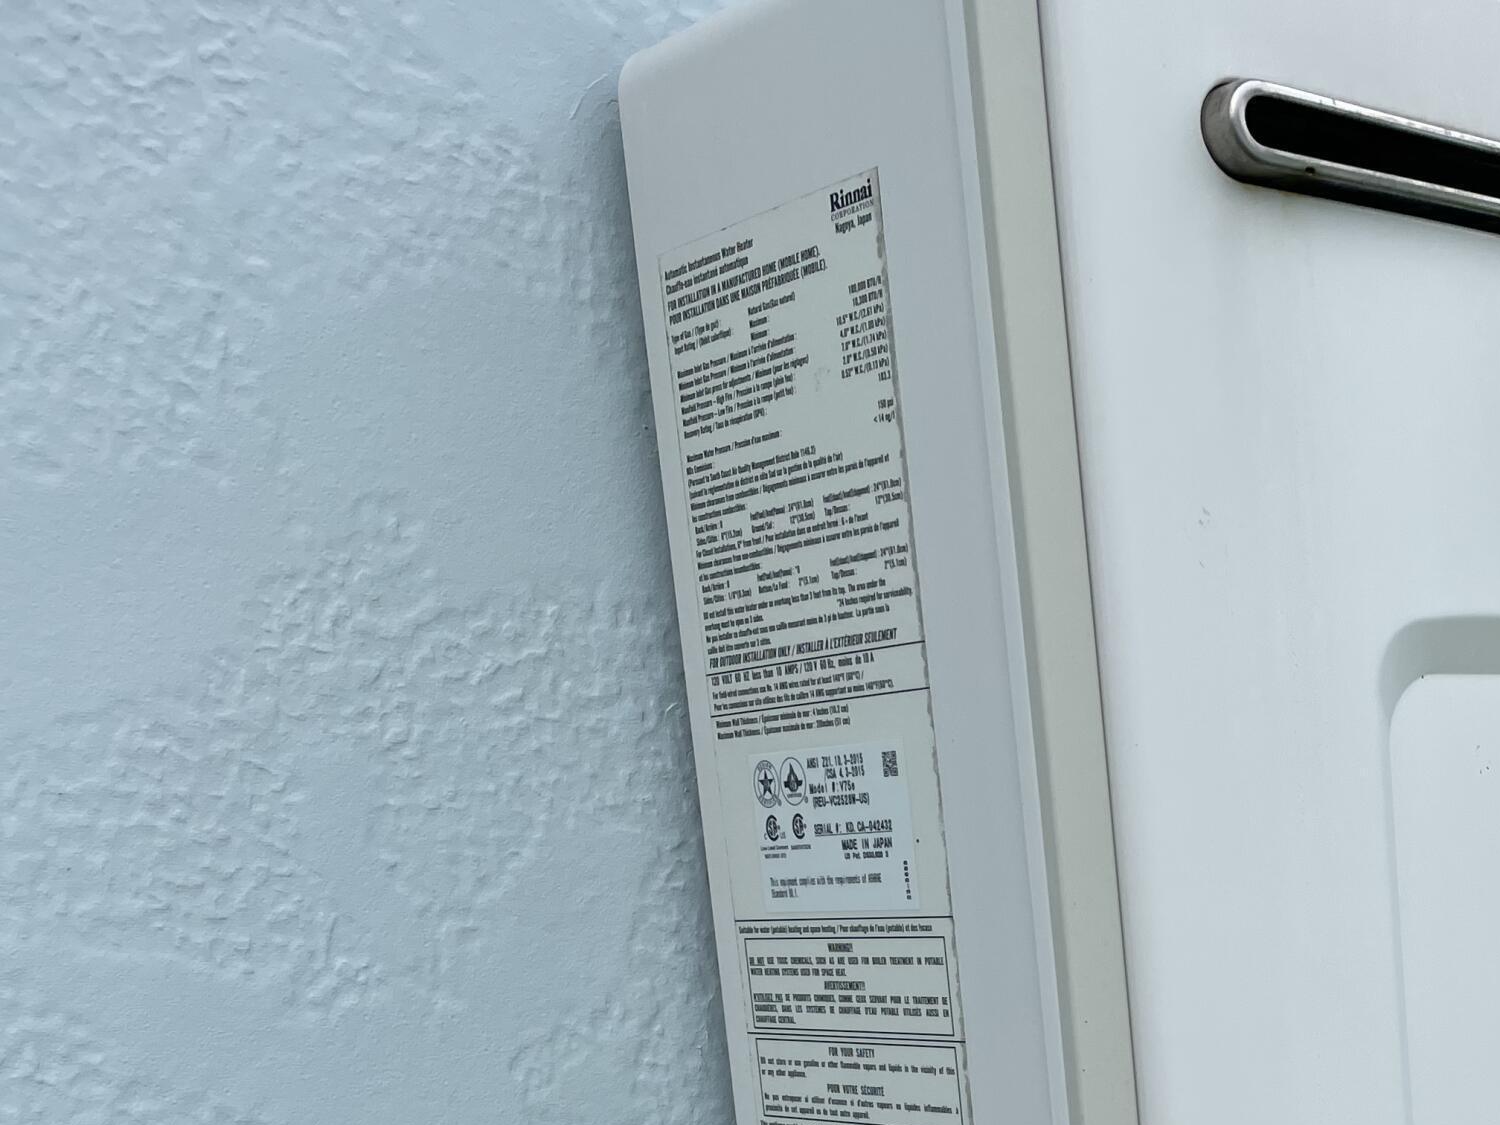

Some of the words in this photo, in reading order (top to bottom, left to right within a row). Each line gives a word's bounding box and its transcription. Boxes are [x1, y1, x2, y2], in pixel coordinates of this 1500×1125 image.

[829, 177, 872, 212] Rinnai
[667, 299, 676, 312] FOR
[677, 286, 710, 308] INSTALLATION
[721, 266, 761, 291] MANUFACTURED
[762, 260, 776, 276] HOME
[777, 252, 799, 271] (MOBILE
[669, 311, 681, 326] POUR
[682, 299, 715, 321] INSTALLATION
[716, 294, 729, 308] DANS
[730, 290, 739, 303] UNE
[741, 282, 760, 299] MAISON
[709, 657, 718, 669] FOR
[742, 647, 777, 663] INSTALLATION
[777, 645, 790, 657] ONLY
[864, 627, 897, 644] SEULEMENT
[721, 673, 732, 685] VOLT
[751, 669, 761, 680] less
[763, 667, 773, 678] than
[805, 757, 819, 768] ANSI
[808, 782, 827, 794] Model
[813, 822, 832, 835] SERIAL
[841, 838, 857, 850] MADE
[872, 836, 892, 848] JAPAN
[828, 1046, 837, 1056] FOR
[840, 1047, 853, 1056] YOUR
[856, 1048, 874, 1058] SAFETY
[827, 1083, 839, 1093] POUR
[842, 1084, 857, 1094] VOTRE
